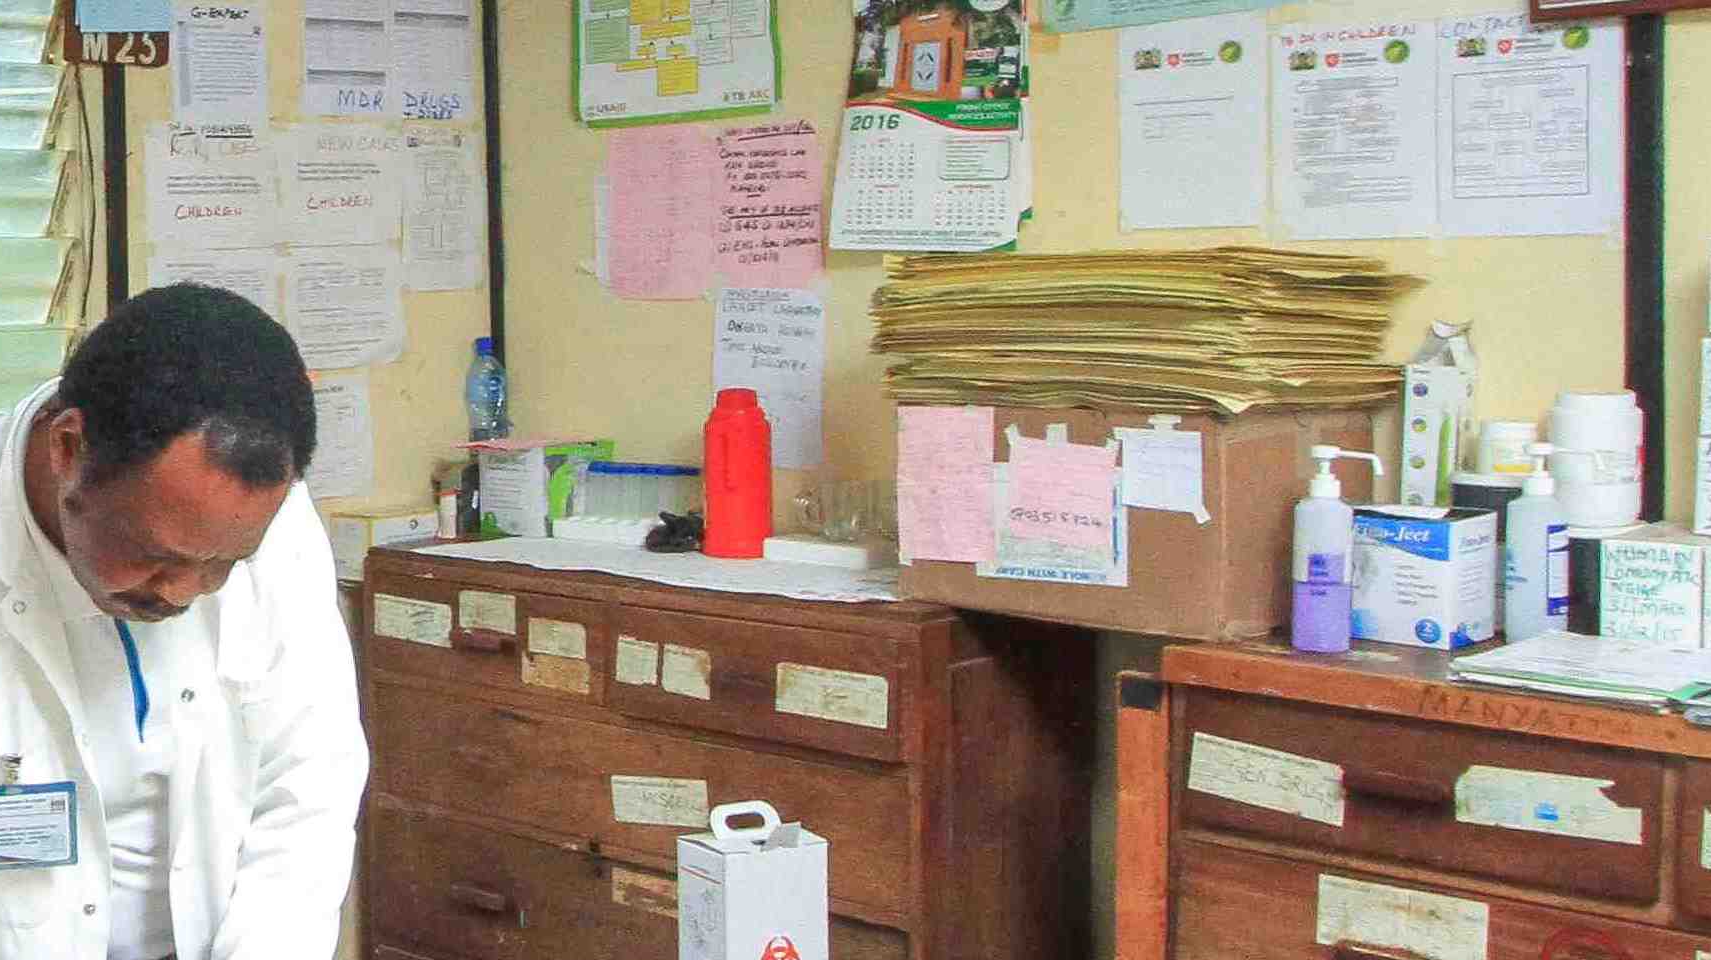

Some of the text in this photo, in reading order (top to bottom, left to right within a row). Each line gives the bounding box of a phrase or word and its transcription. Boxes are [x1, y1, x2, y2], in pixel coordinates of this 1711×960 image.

[338, 89, 385, 113] MDR
[849, 113, 901, 132] 2016
[306, 190, 373, 211] CHILDREN
[175, 204, 243, 221] CHILDREN
